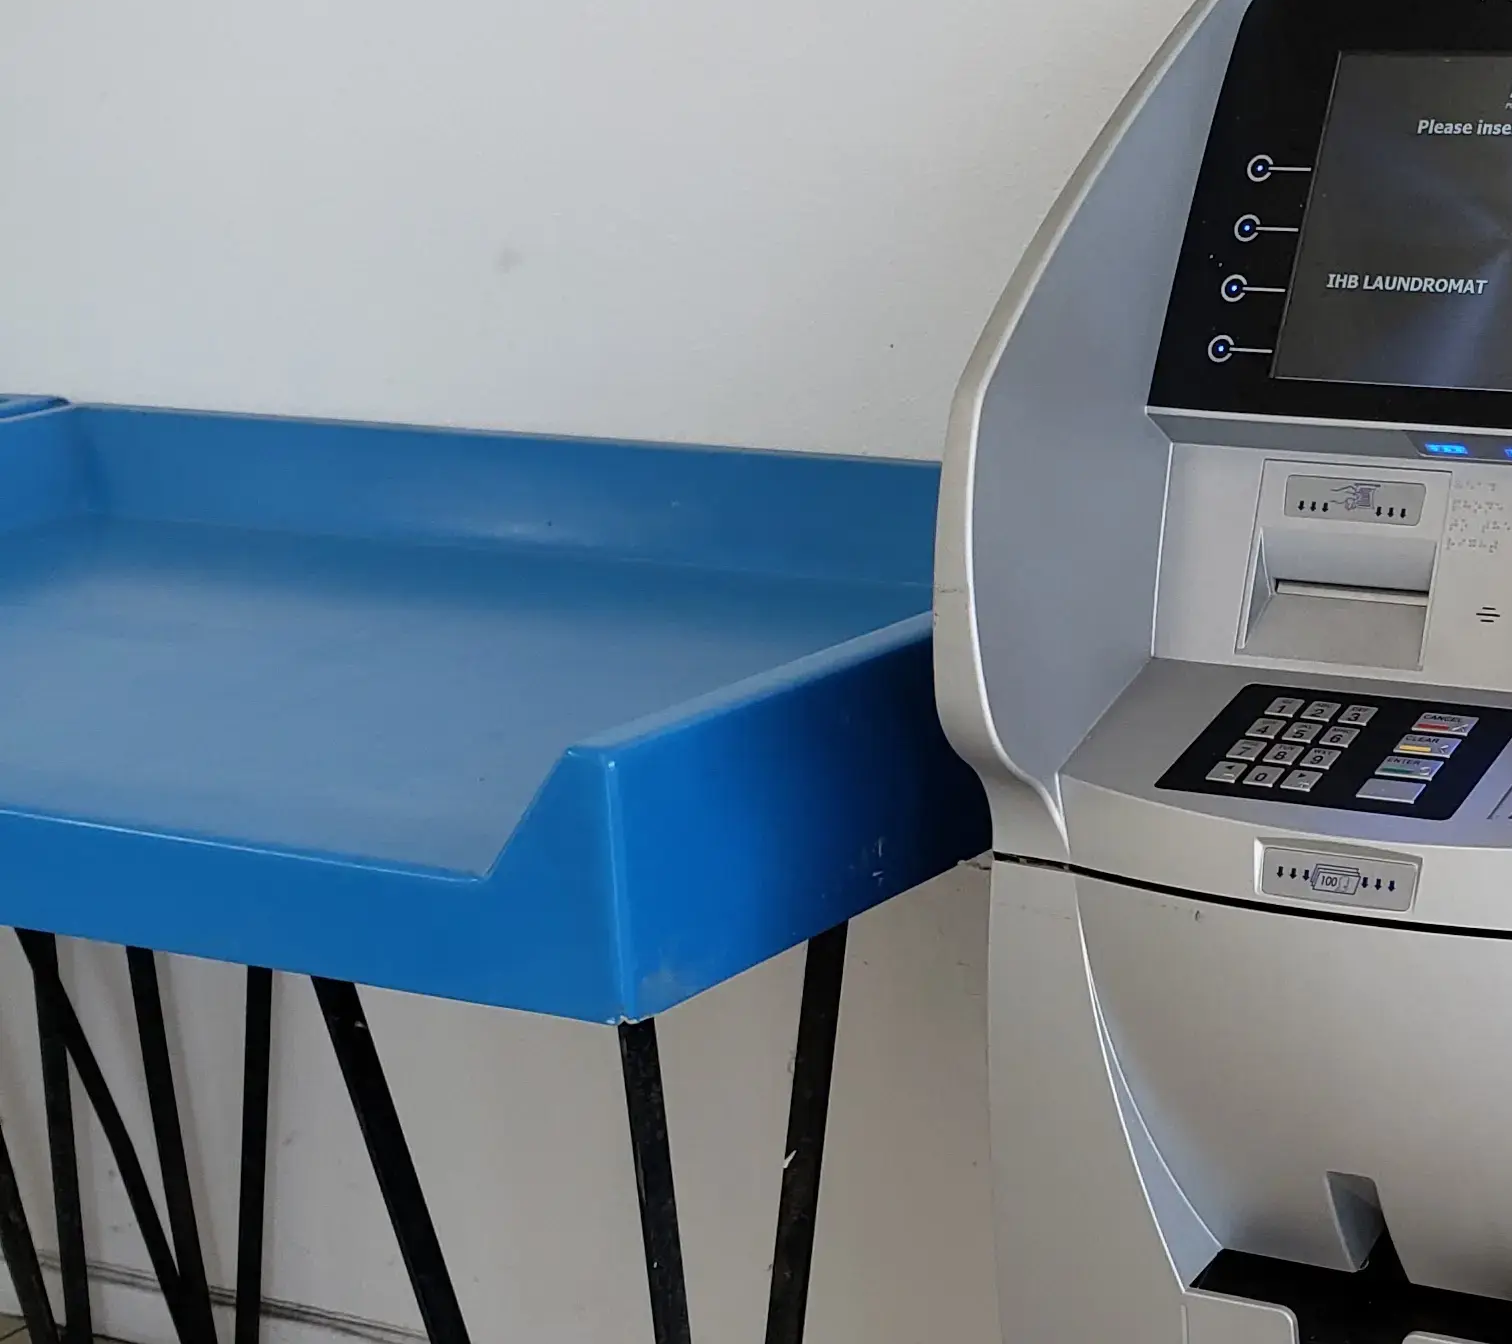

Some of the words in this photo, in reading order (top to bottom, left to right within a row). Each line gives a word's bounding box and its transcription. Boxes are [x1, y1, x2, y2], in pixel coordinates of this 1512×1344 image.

[1417, 120, 1472, 135] Please
[1326, 274, 1359, 289] IHB
[1363, 275, 1488, 294] LAUNDROMAT
[1309, 708, 1324, 718] 2
[1348, 712, 1360, 722] 3
[1330, 734, 1344, 744] 6
[1405, 736, 1440, 744] CLEAR
[1273, 750, 1288, 760] 8
[1310, 755, 1324, 765] 9
[1387, 757, 1421, 766] ENTER
[1320, 875, 1338, 887] 100
